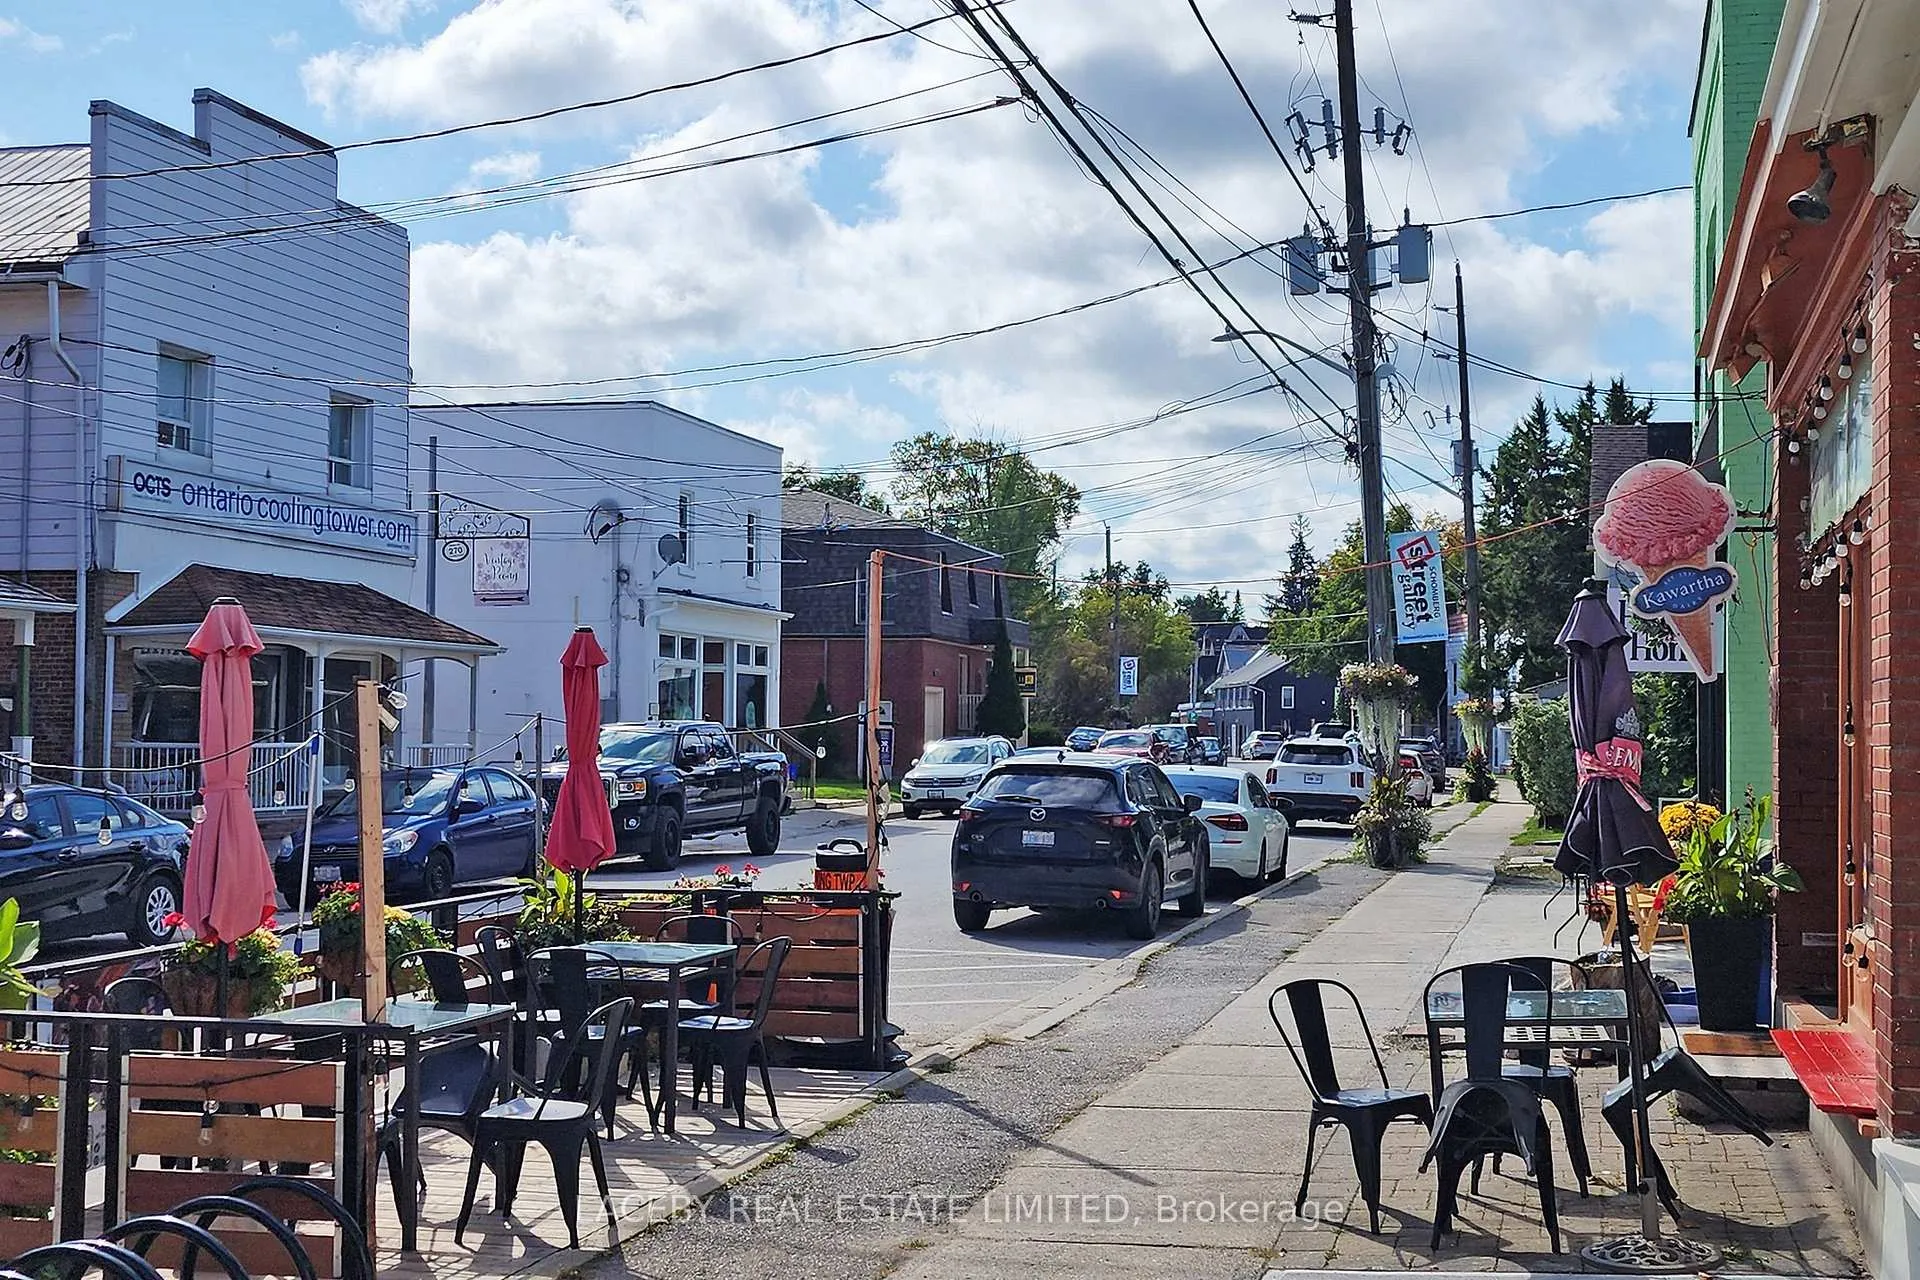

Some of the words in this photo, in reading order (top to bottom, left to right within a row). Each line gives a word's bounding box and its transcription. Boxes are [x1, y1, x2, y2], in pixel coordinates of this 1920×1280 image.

[182, 481, 253, 515] ontario
[448, 546, 463, 556] 270
[1397, 574, 1416, 630] gallery
[1410, 546, 1433, 622] street
[1428, 566, 1441, 618] SCHOMBERG
[1642, 574, 1726, 609] Kawartha
